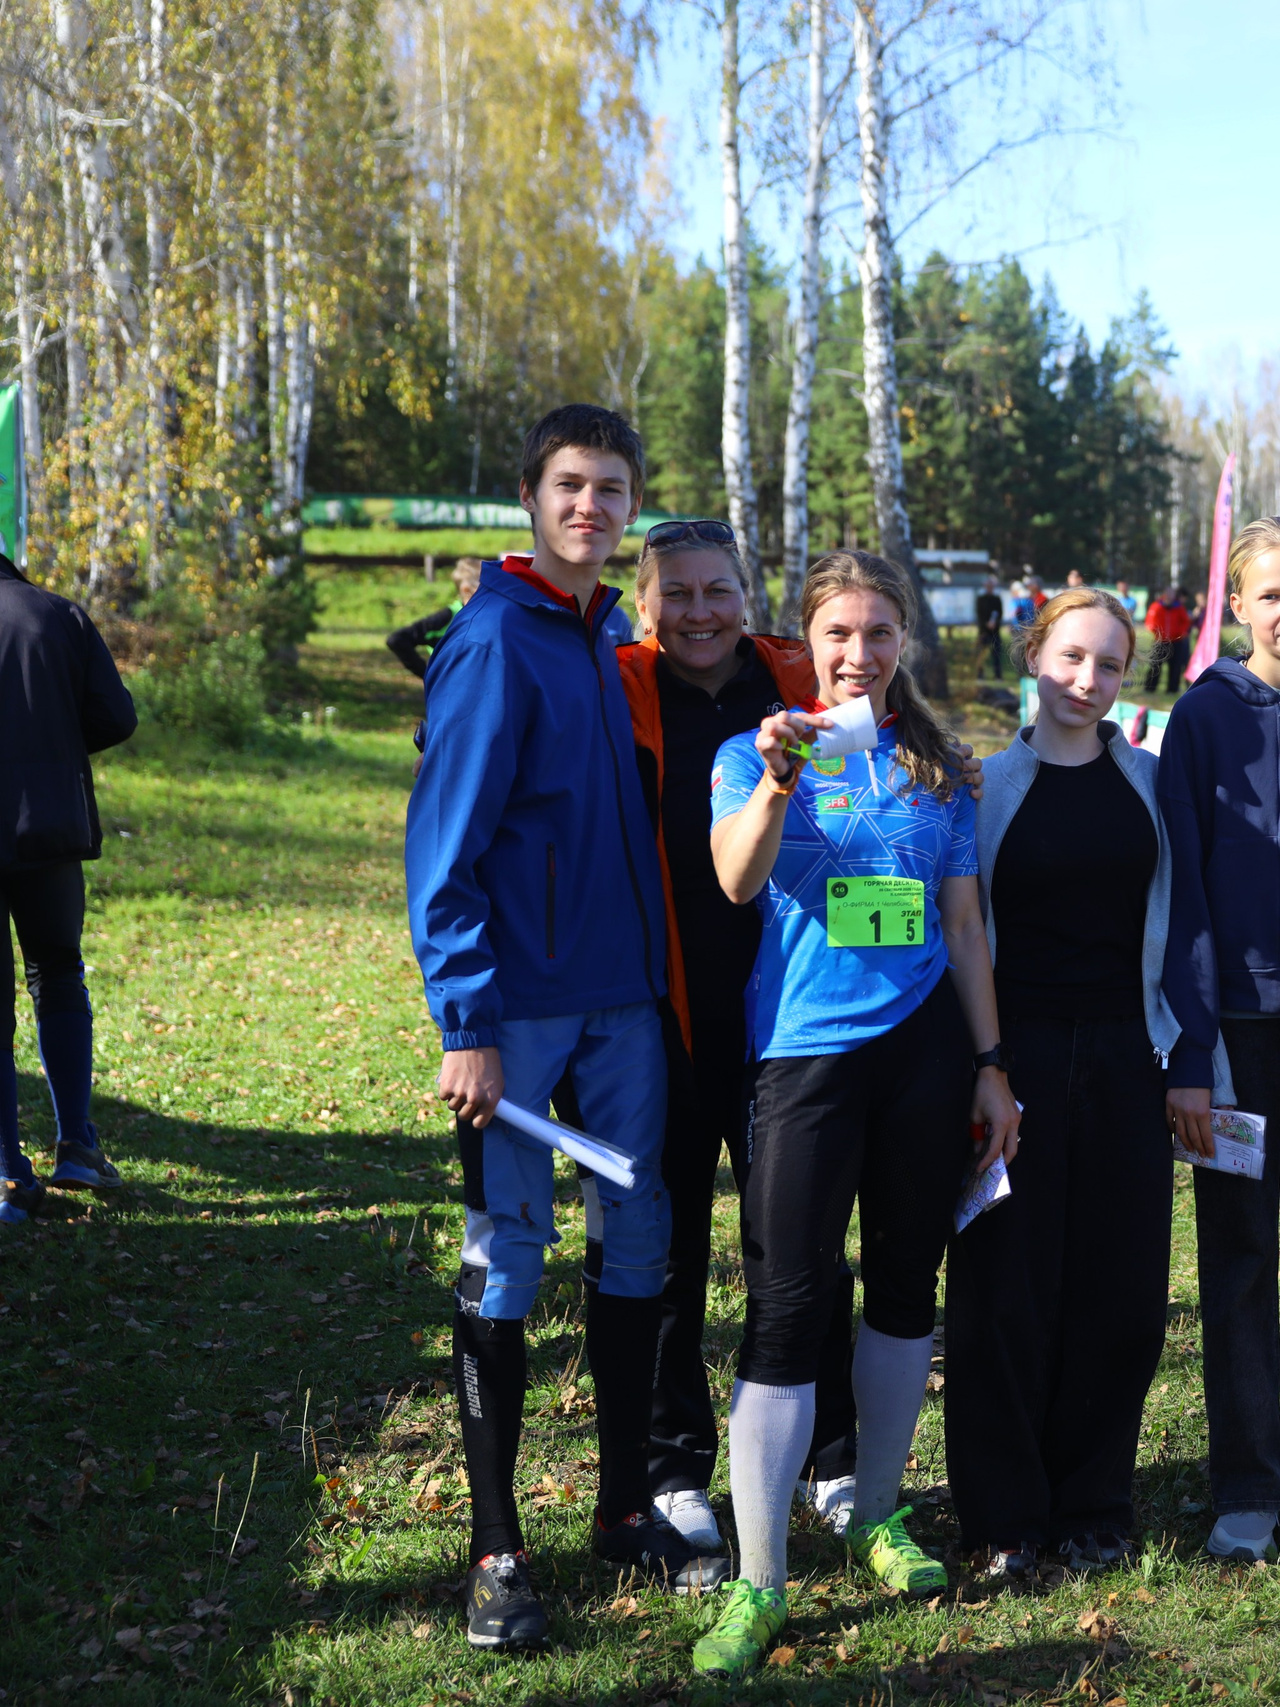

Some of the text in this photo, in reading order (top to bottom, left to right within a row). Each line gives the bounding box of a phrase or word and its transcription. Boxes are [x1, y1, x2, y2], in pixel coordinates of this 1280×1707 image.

[824, 797, 846, 807] SFR
[901, 910, 923, 918] ЭТАП
[869, 910, 881, 943] 1
[906, 918, 916, 942] 5
